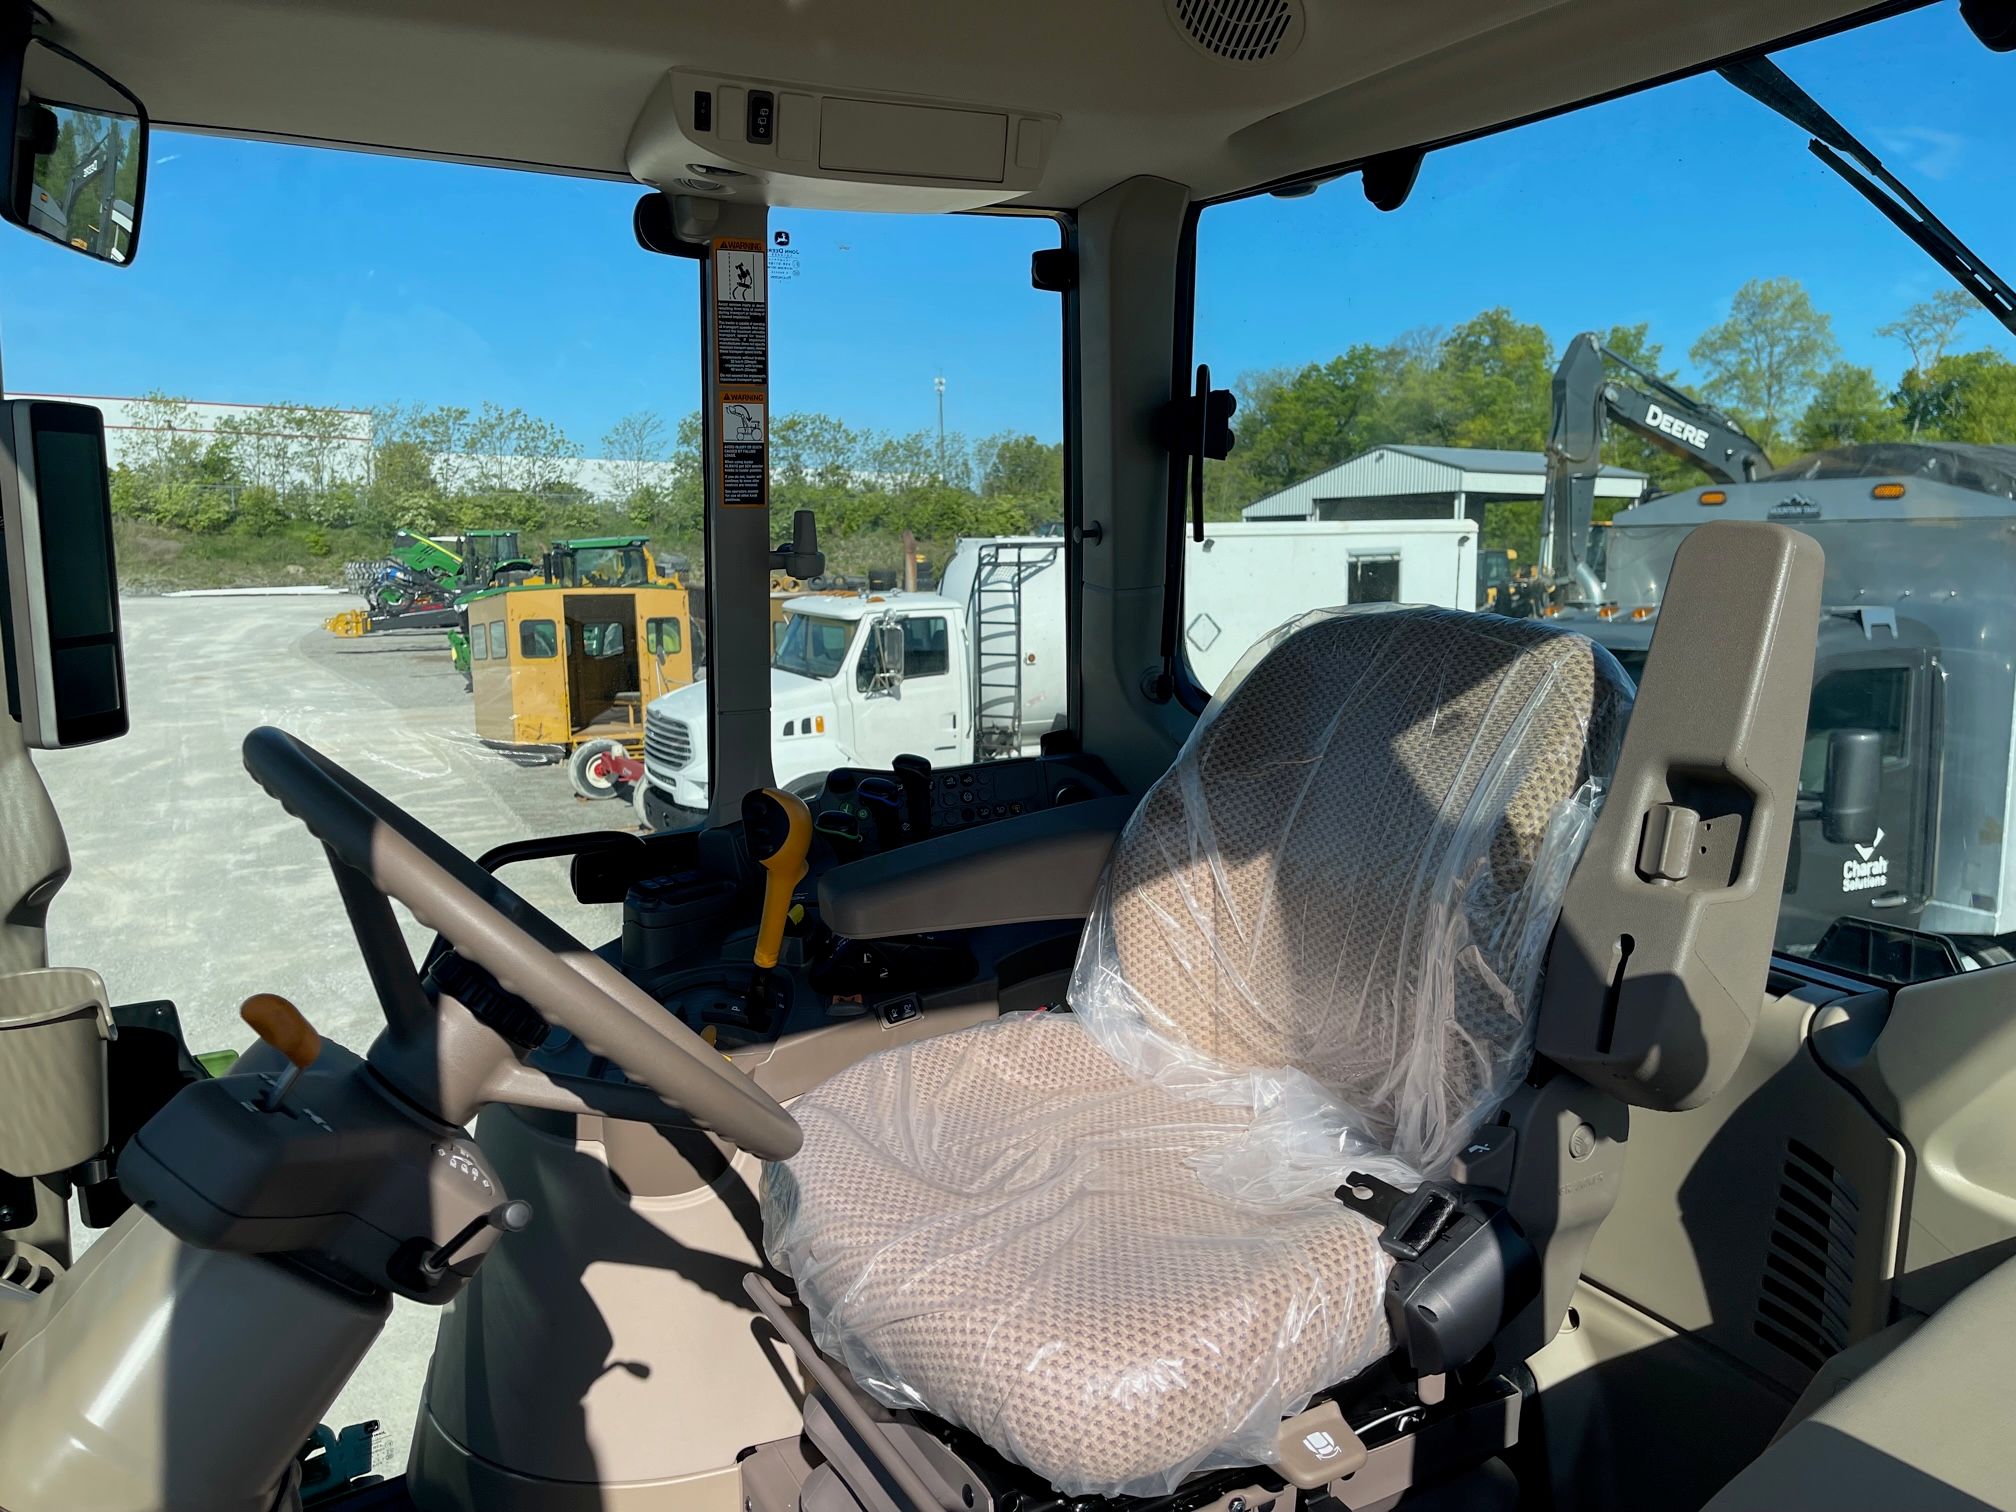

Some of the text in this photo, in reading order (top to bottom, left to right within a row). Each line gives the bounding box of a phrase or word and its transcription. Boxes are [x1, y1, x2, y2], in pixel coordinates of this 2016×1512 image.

[728, 240, 763, 251] WARNING
[730, 393, 764, 401] WARNING
[1644, 403, 1710, 450] DEERE
[1843, 856, 1888, 879] Charah
[1842, 874, 1888, 893] Solutions
